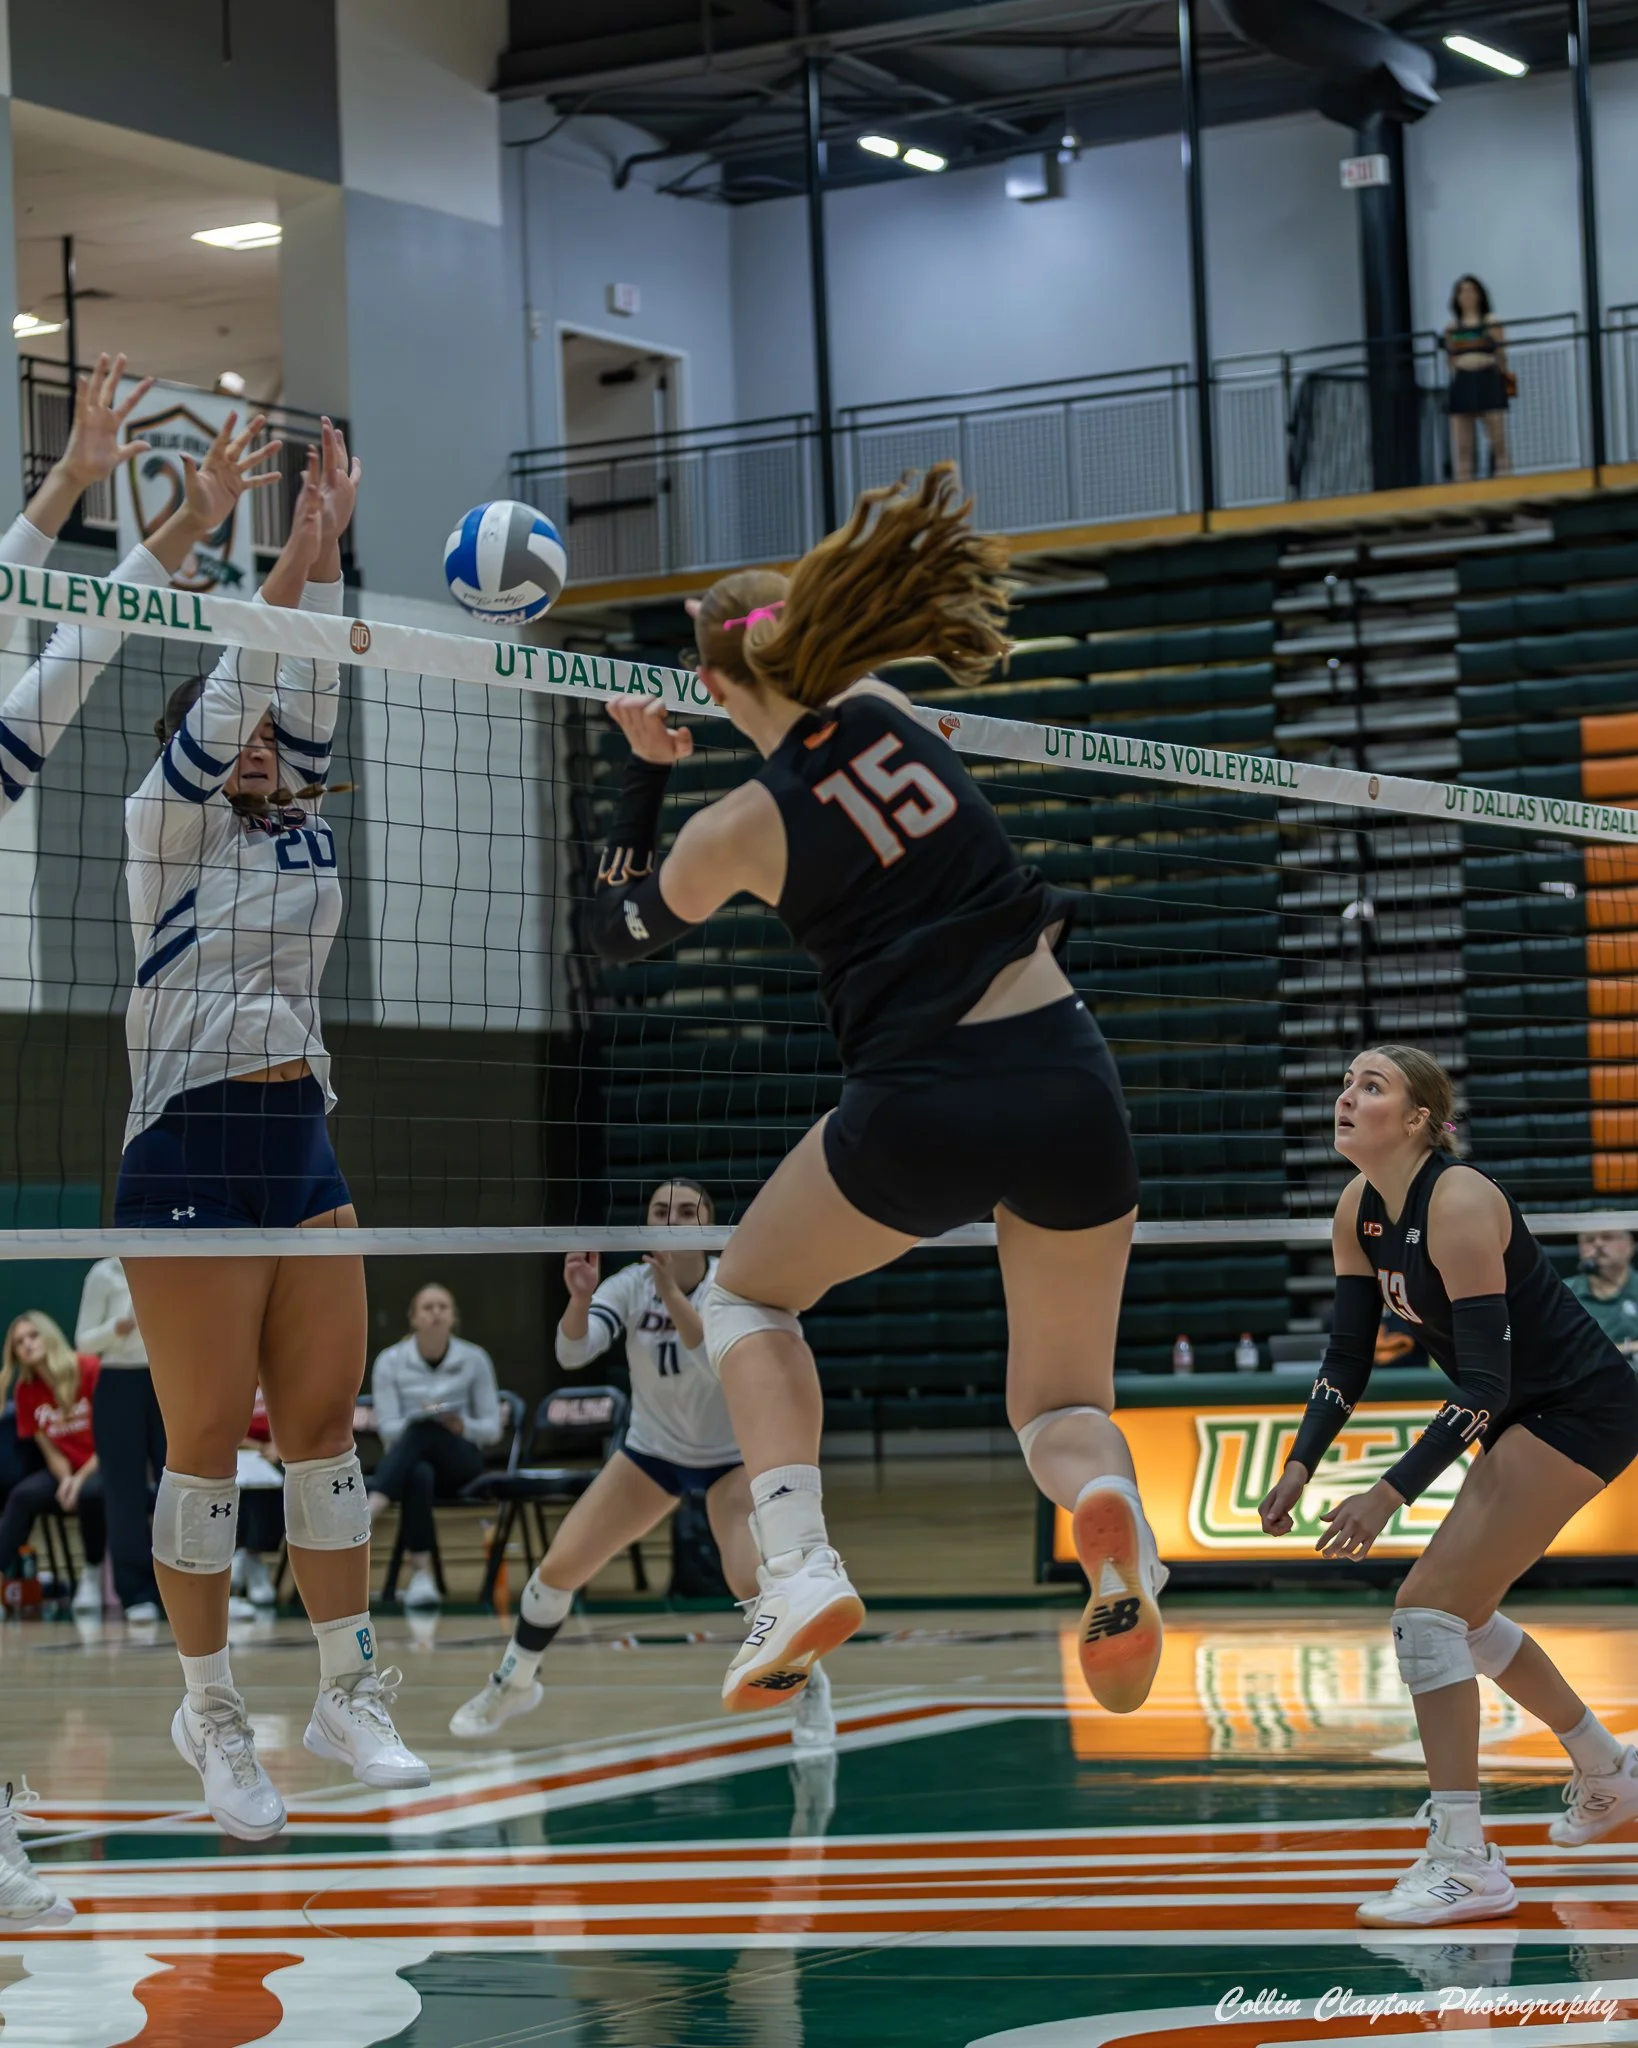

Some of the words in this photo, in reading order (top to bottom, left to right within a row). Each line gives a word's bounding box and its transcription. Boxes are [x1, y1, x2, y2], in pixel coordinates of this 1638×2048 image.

[495, 643, 538, 679] UT
[548, 650, 664, 698] DALLAS
[1045, 727, 1076, 758] UT
[1082, 733, 1166, 770] DALLAS
[1170, 745, 1299, 789] VOLLEYBALL
[811, 731, 958, 868] 15
[1445, 786, 1468, 811] UT
[1472, 790, 1537, 821] DALLAS
[1541, 800, 1638, 834] VOLLEYBALL
[275, 828, 337, 870] 20
[658, 1340, 681, 1377] 11
